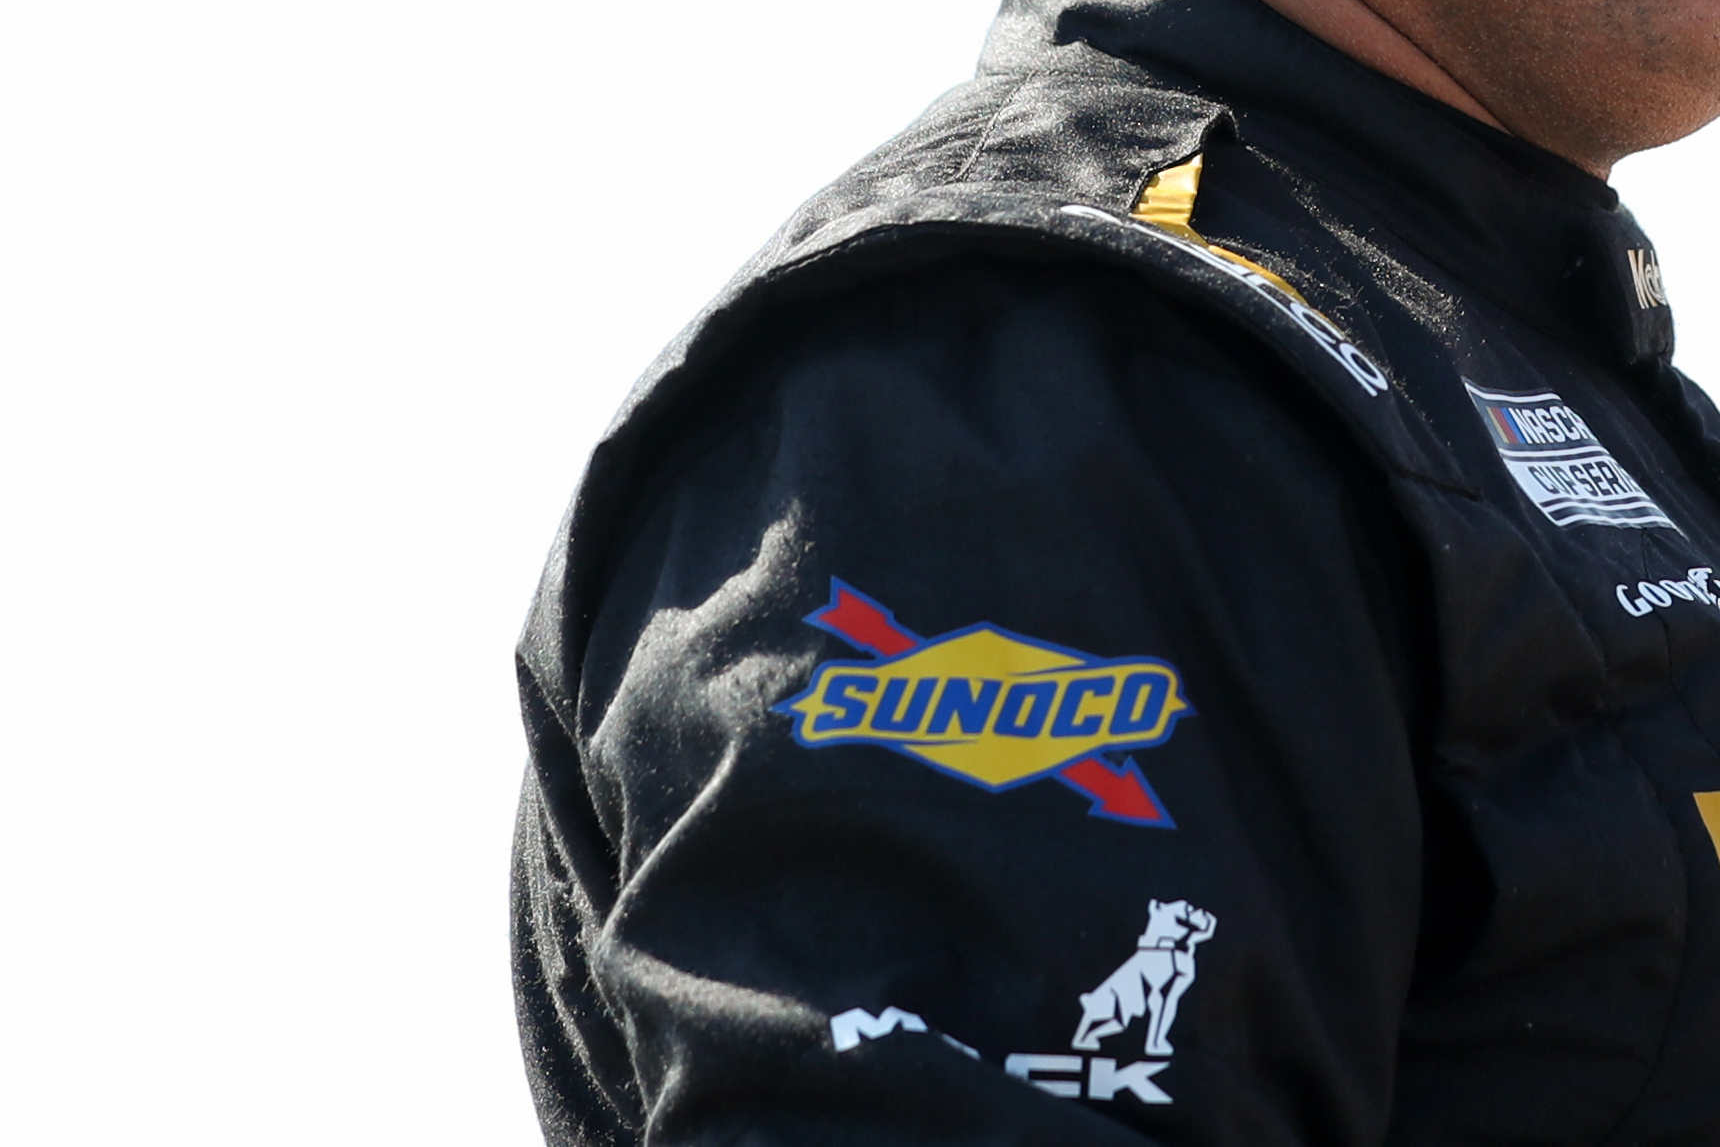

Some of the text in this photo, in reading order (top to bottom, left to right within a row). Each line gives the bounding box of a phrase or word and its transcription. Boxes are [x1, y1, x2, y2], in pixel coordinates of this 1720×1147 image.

[1508, 405, 1599, 444] NASCA
[1528, 460, 1644, 497] CUP SERIE
[812, 672, 1171, 739] SUNOCO
[829, 1006, 1174, 1105] MCK
